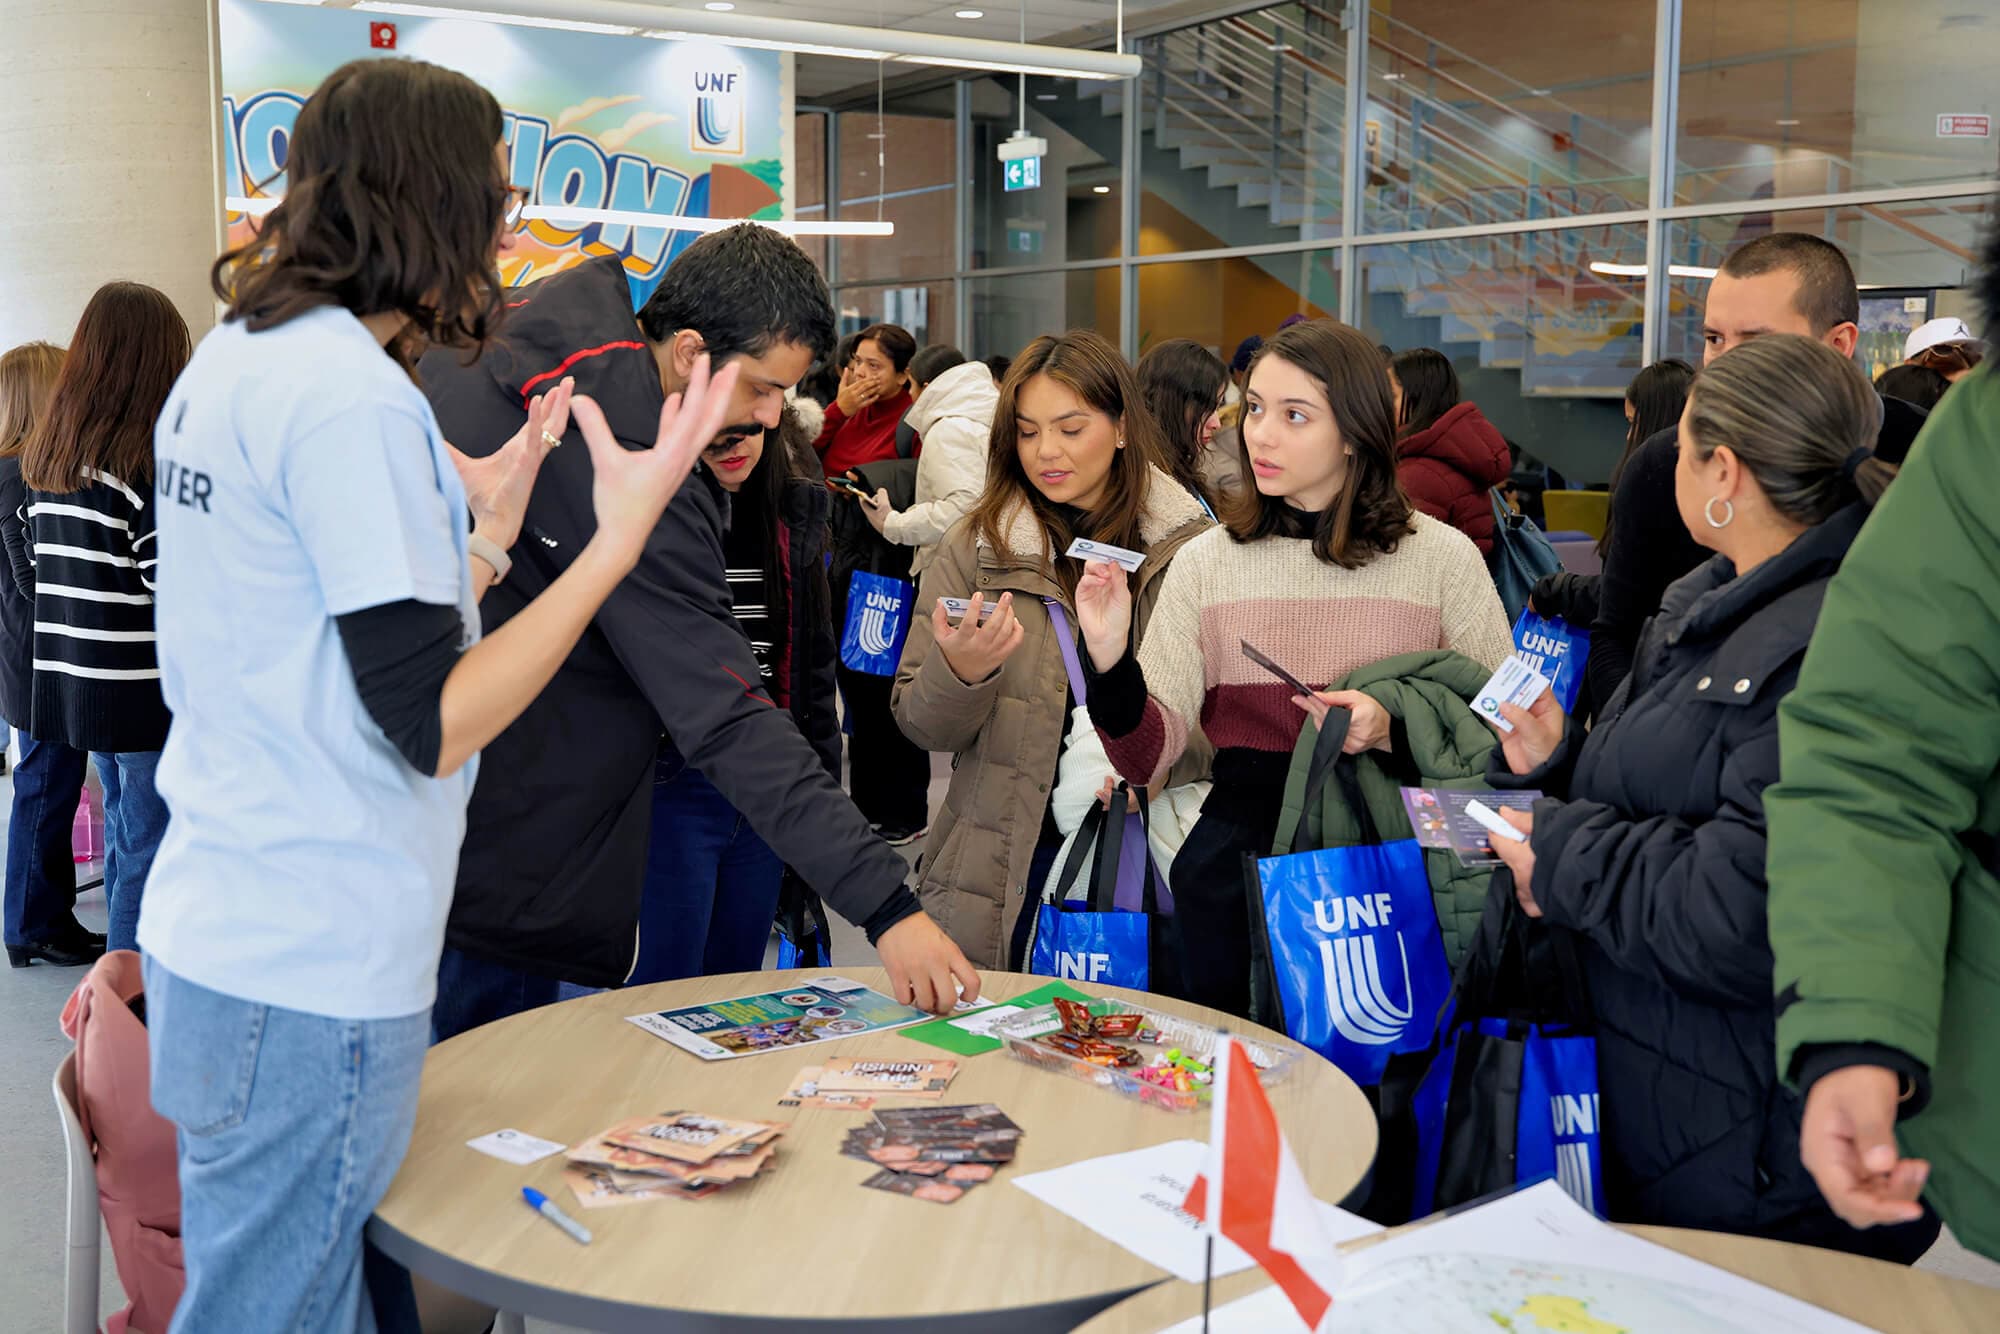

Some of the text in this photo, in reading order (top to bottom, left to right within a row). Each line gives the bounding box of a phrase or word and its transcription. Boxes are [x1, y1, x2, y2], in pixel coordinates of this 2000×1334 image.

[695, 71, 737, 92] UNF
[866, 591, 901, 612] UNF
[1522, 630, 1569, 658] UNF
[1314, 893, 1393, 933] UNF
